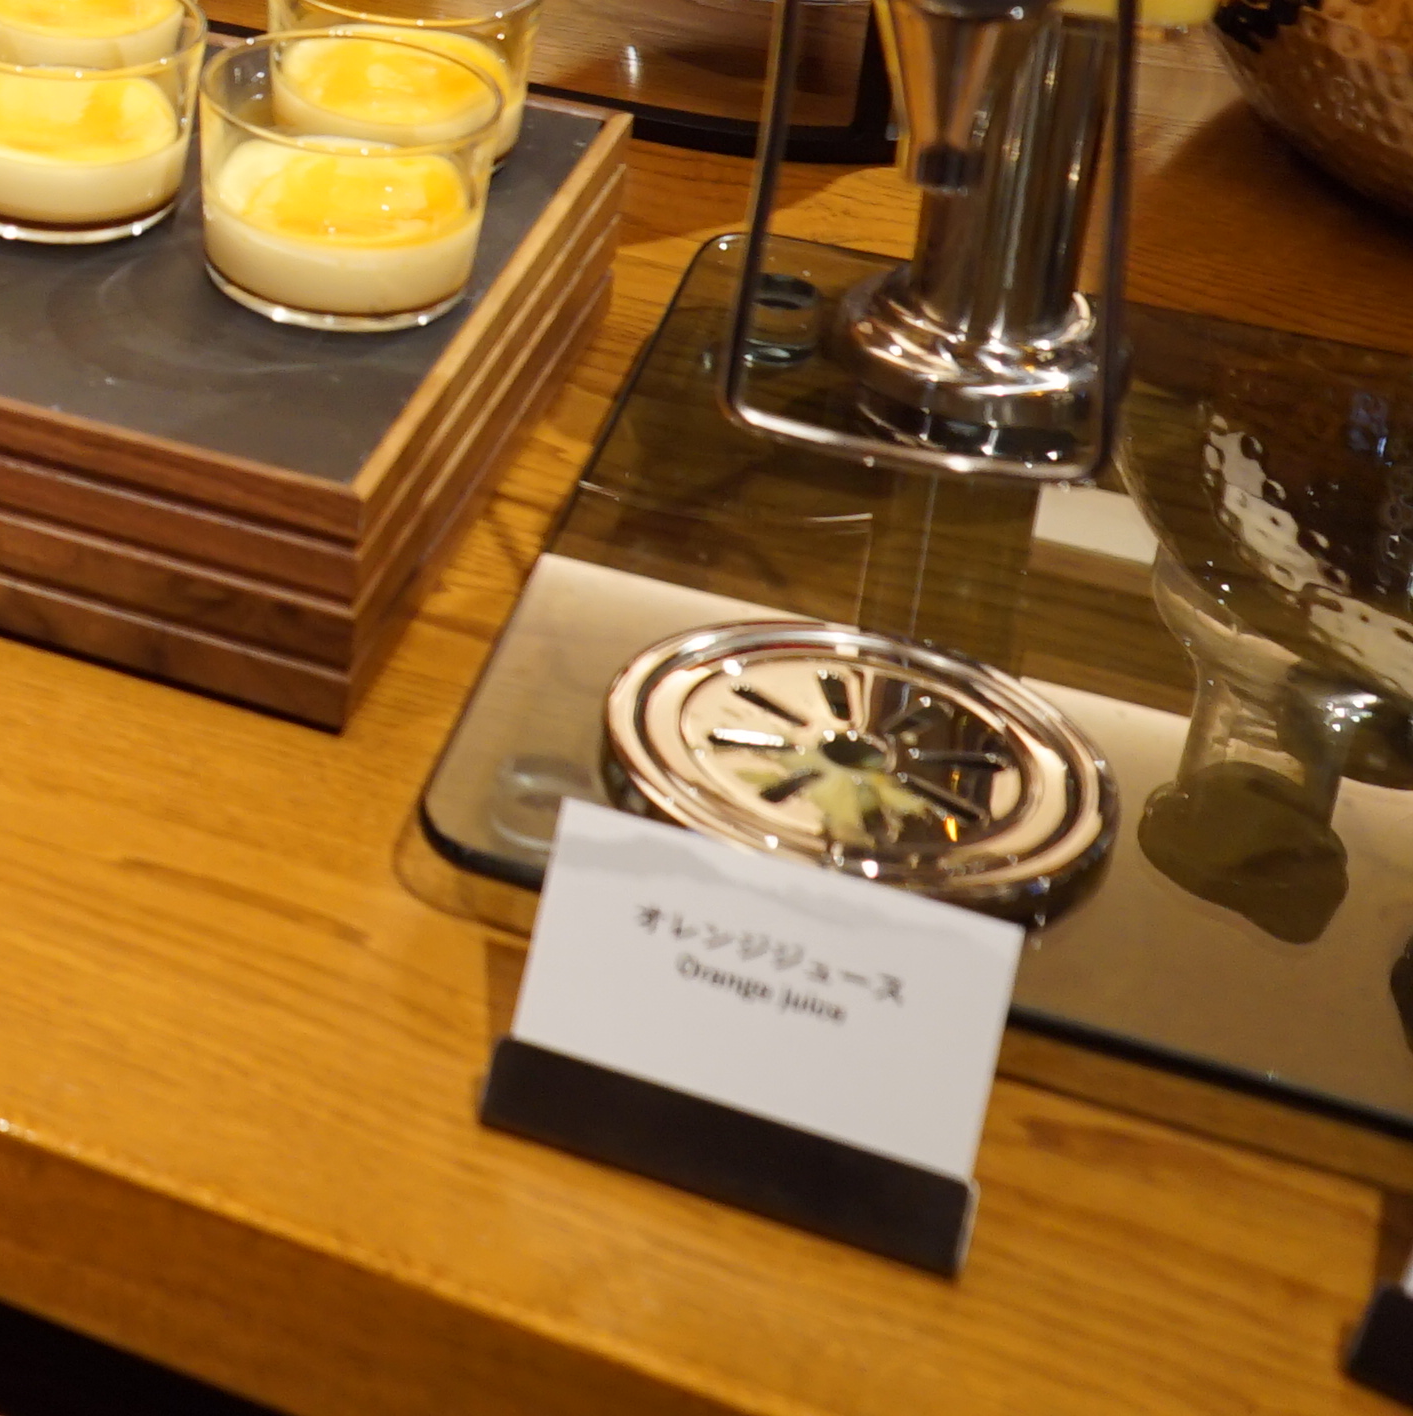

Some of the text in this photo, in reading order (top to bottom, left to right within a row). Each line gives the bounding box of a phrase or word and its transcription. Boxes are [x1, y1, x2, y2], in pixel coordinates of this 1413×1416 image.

[634, 902, 905, 1006] オレンジジュース
[675, 951, 848, 1025] Orange juice
